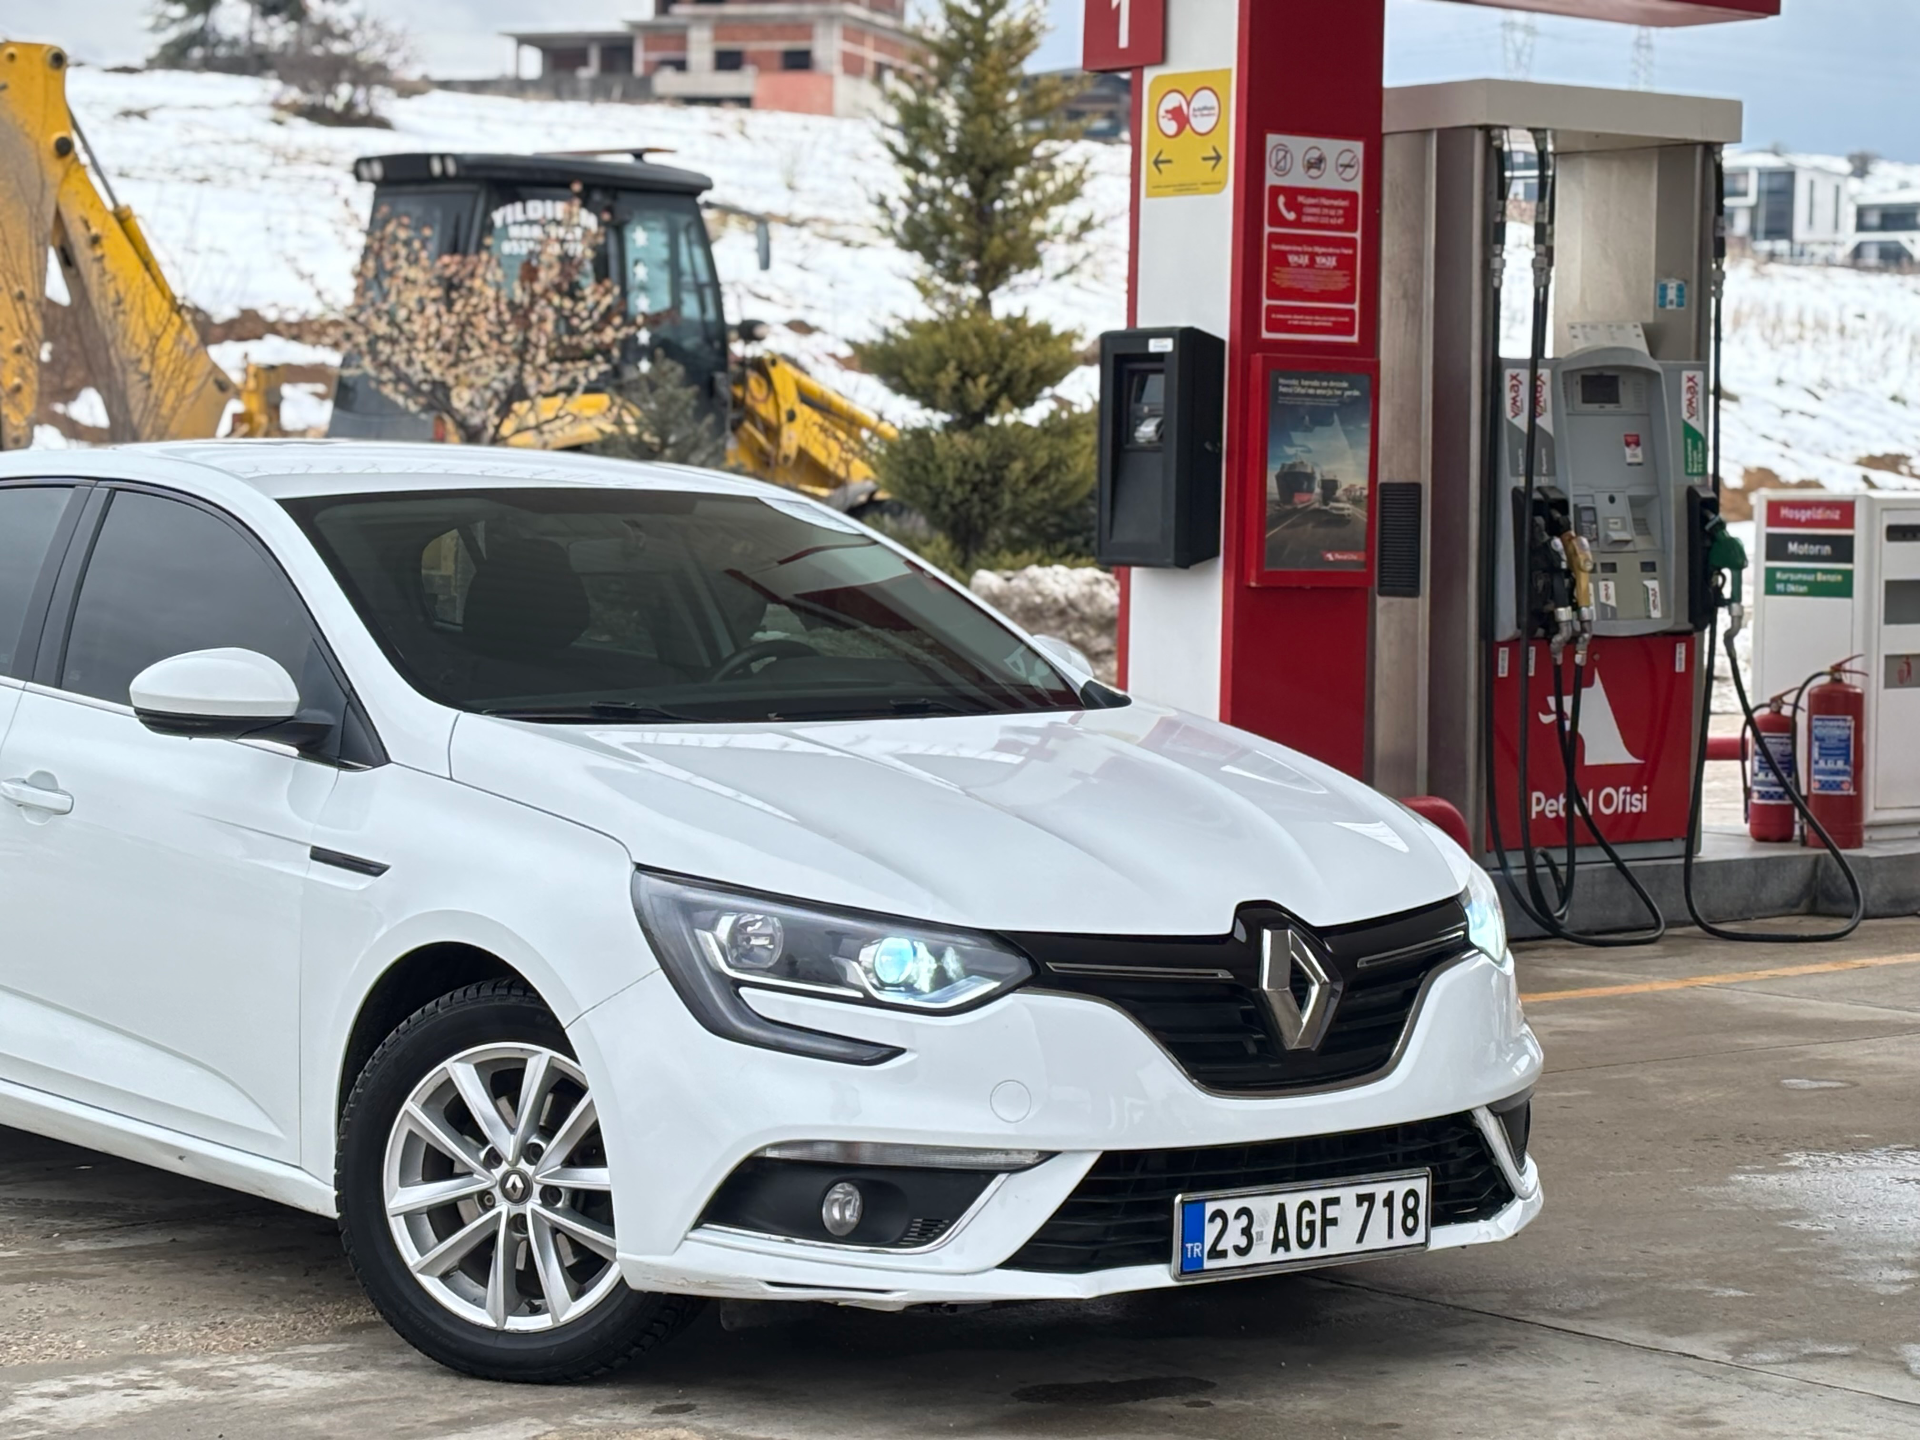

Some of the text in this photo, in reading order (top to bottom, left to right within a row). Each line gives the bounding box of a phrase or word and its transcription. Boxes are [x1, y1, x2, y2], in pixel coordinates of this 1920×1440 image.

[1598, 785, 1648, 816] Ofisi
[1206, 1188, 1420, 1260] 23 AGF 718
[1185, 1242, 1202, 1259] TR
